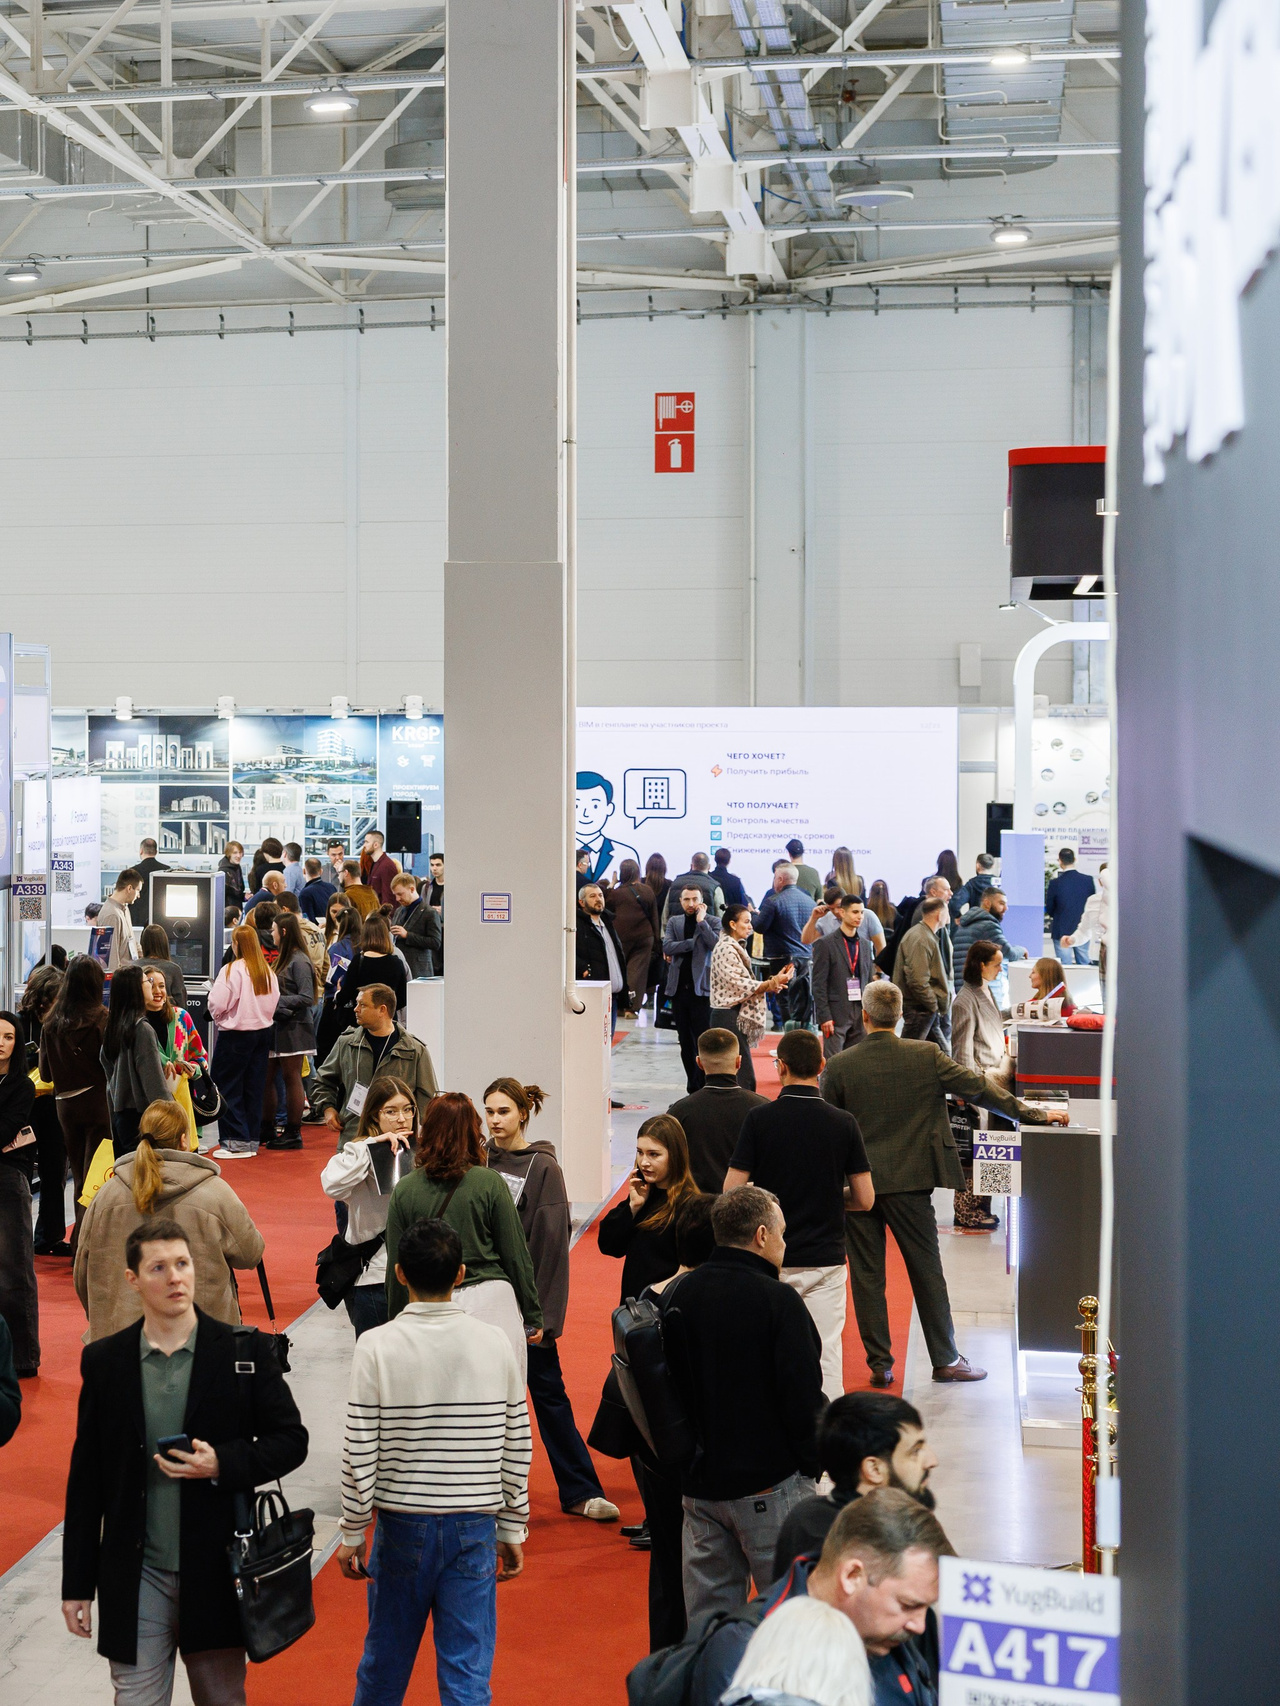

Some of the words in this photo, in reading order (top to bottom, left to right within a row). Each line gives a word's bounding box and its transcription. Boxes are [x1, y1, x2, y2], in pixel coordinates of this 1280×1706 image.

[392, 726, 440, 741] KRGP
[727, 768, 768, 776] Получить
[770, 768, 809, 776] прибыль
[727, 817, 768, 825] Контроль
[53, 861, 73, 871] A343
[16, 885, 45, 894] A339
[989, 1134, 1016, 1142] YugBuild
[976, 1146, 1014, 1160] A421
[1001, 1583, 1105, 1615] YugBuild
[948, 1621, 1107, 1690] A417
